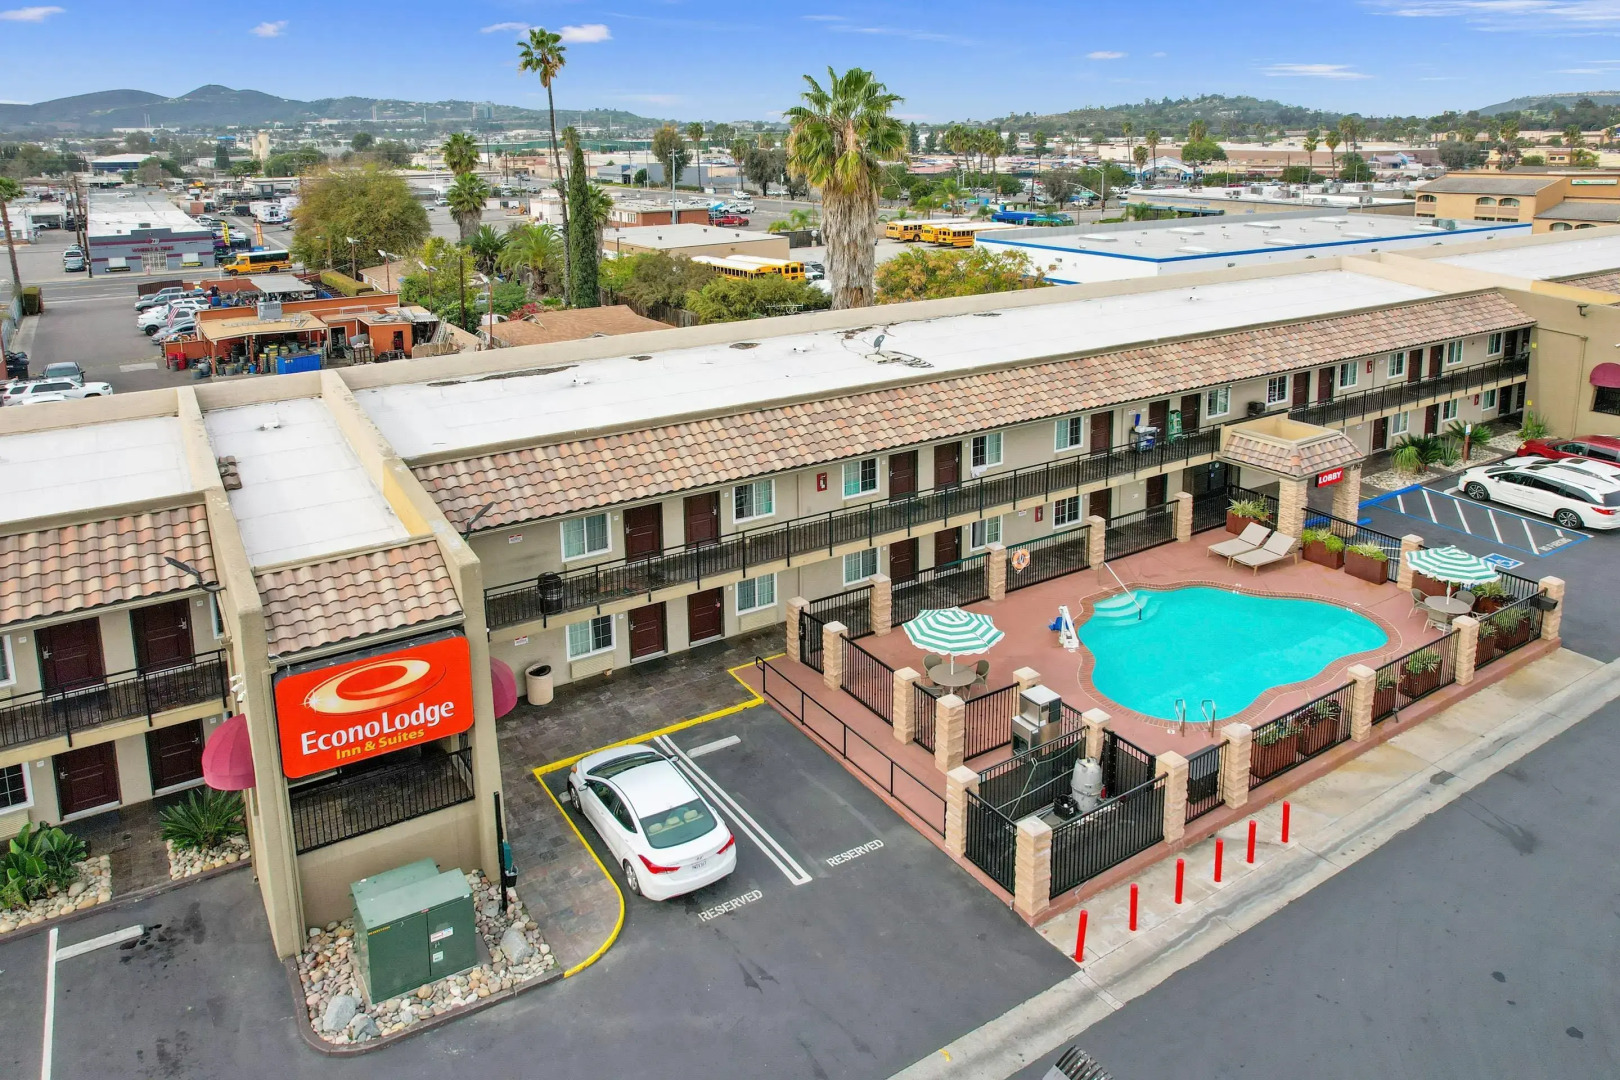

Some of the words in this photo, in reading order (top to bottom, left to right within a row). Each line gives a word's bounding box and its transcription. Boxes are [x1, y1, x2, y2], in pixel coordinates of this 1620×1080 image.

[1318, 471, 1342, 484] LOBBY
[301, 701, 454, 755] EconoLodge
[336, 746, 361, 760] Inn
[364, 740, 376, 752] &
[379, 728, 425, 748] Suites
[826, 839, 884, 867] RESERVED
[698, 889, 763, 922] RESERVED
